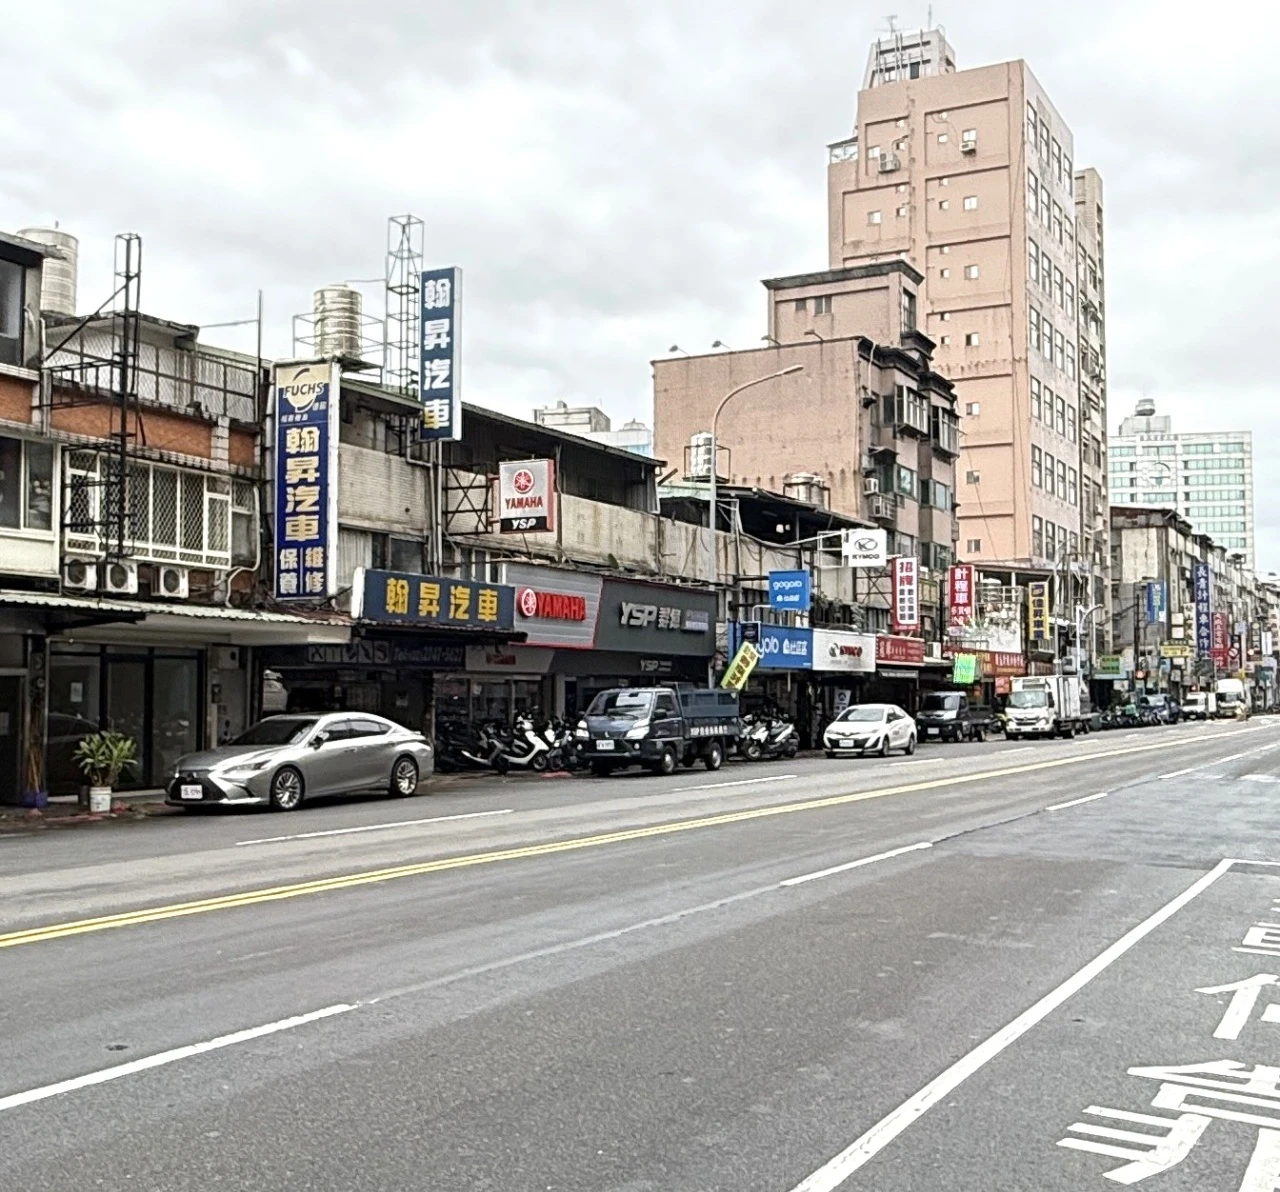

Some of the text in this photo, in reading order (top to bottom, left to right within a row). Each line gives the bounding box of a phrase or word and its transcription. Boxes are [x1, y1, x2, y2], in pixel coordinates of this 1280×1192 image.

[424, 278, 451, 431] 翰昇汽車
[282, 381, 325, 398] FUCHS
[285, 427, 320, 542] 翰昇汽車
[505, 496, 543, 510] YAMAHA
[511, 517, 536, 531] YSP
[305, 546, 324, 594] 維修
[954, 567, 968, 604] 計程車
[385, 577, 499, 623] 翰昇汽車
[535, 595, 588, 621] YAMAHA
[620, 601, 658, 627] YSP
